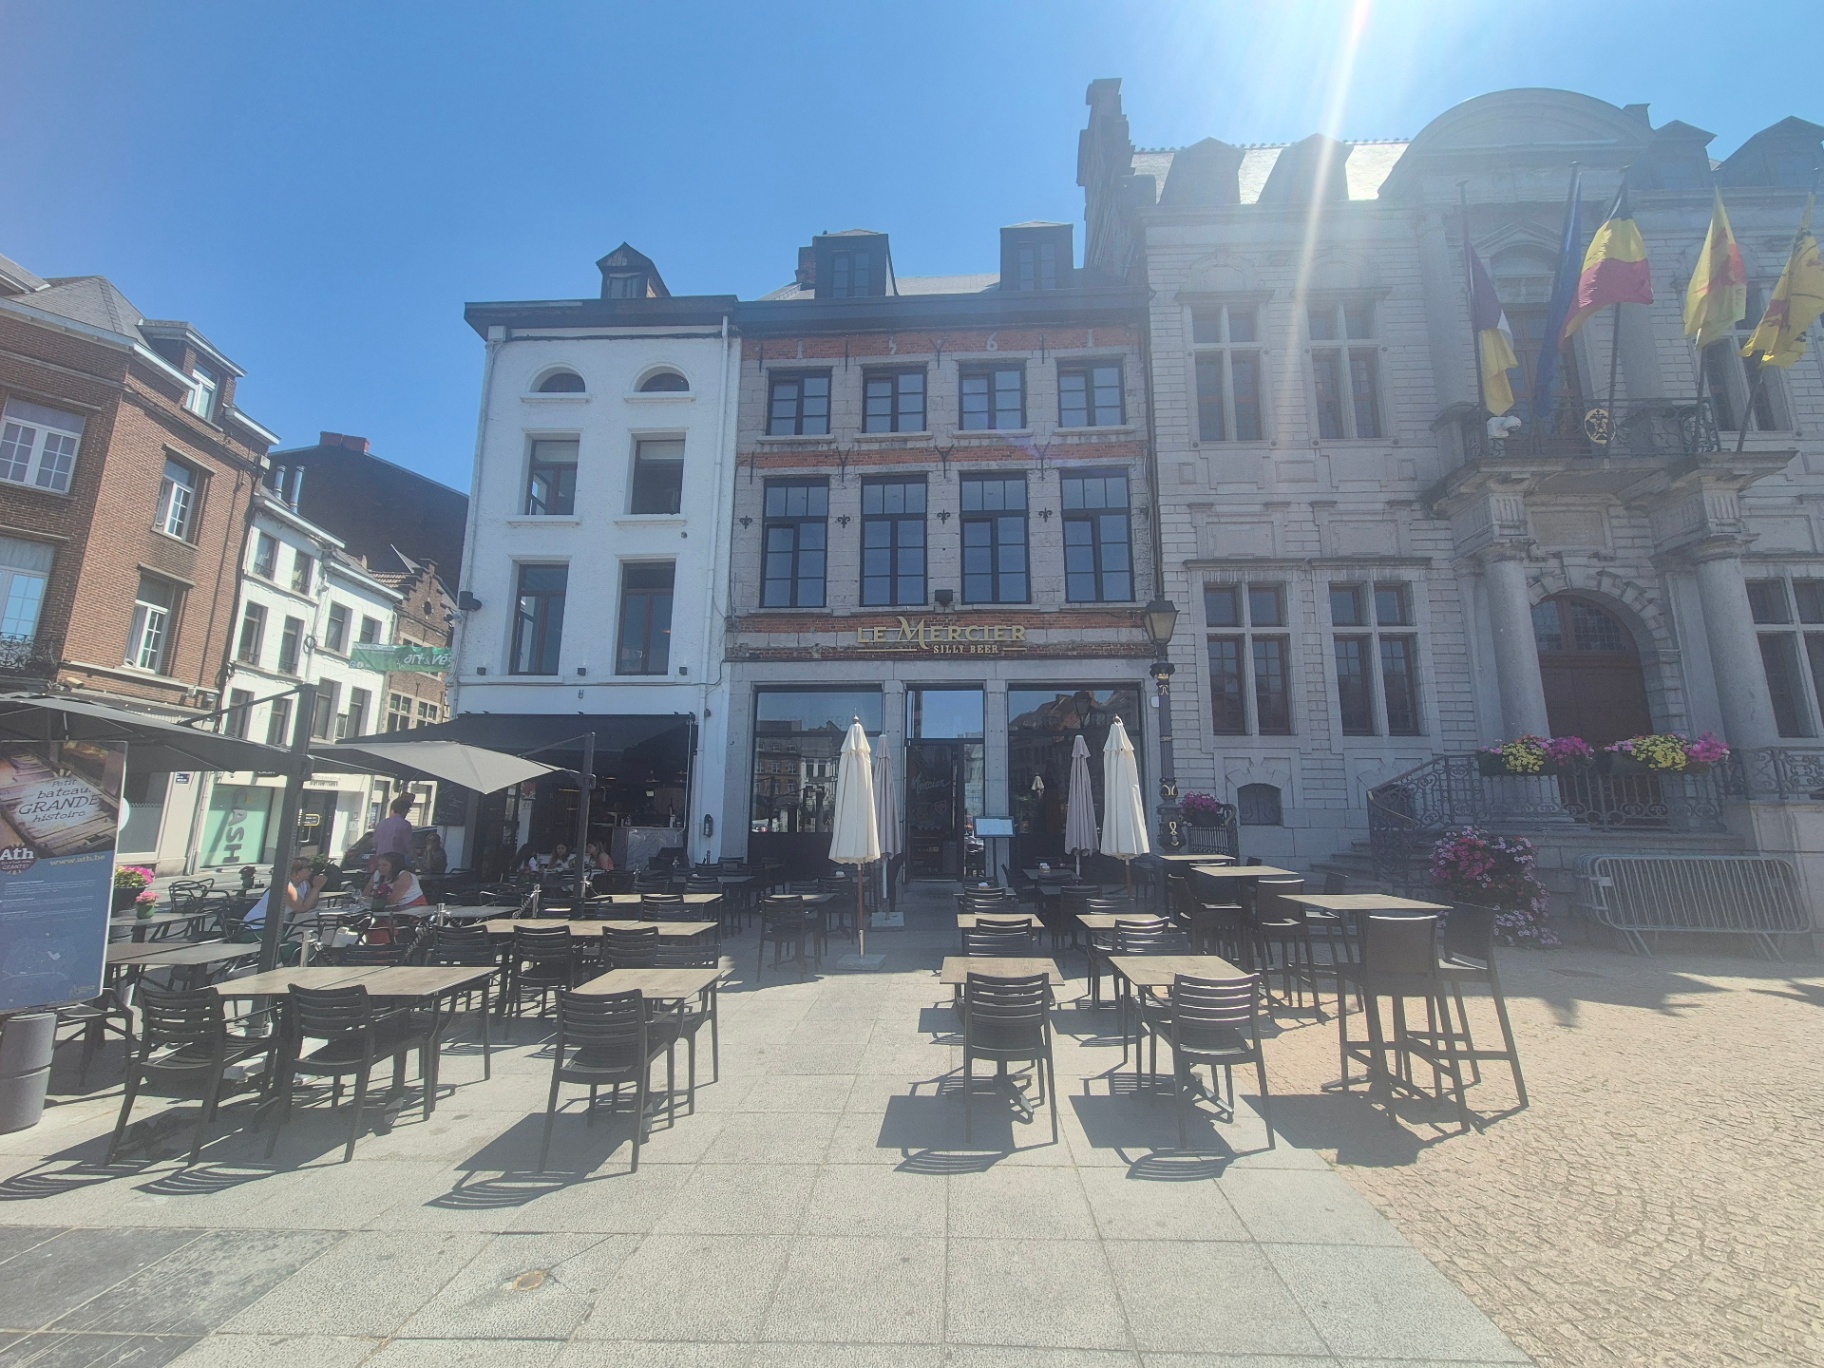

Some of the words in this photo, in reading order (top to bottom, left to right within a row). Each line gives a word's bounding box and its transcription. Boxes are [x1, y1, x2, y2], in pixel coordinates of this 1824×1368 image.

[857, 626, 887, 643] LE
[897, 616, 1026, 650] MERCIER
[933, 645, 964, 654] SILLY
[970, 645, 999, 654] BEER
[52, 779, 77, 788] Petit
[18, 794, 102, 814] GRANDE
[33, 810, 86, 822] histoire
[0, 847, 34, 860] Ath
[49, 854, 105, 866] www.ath.be
